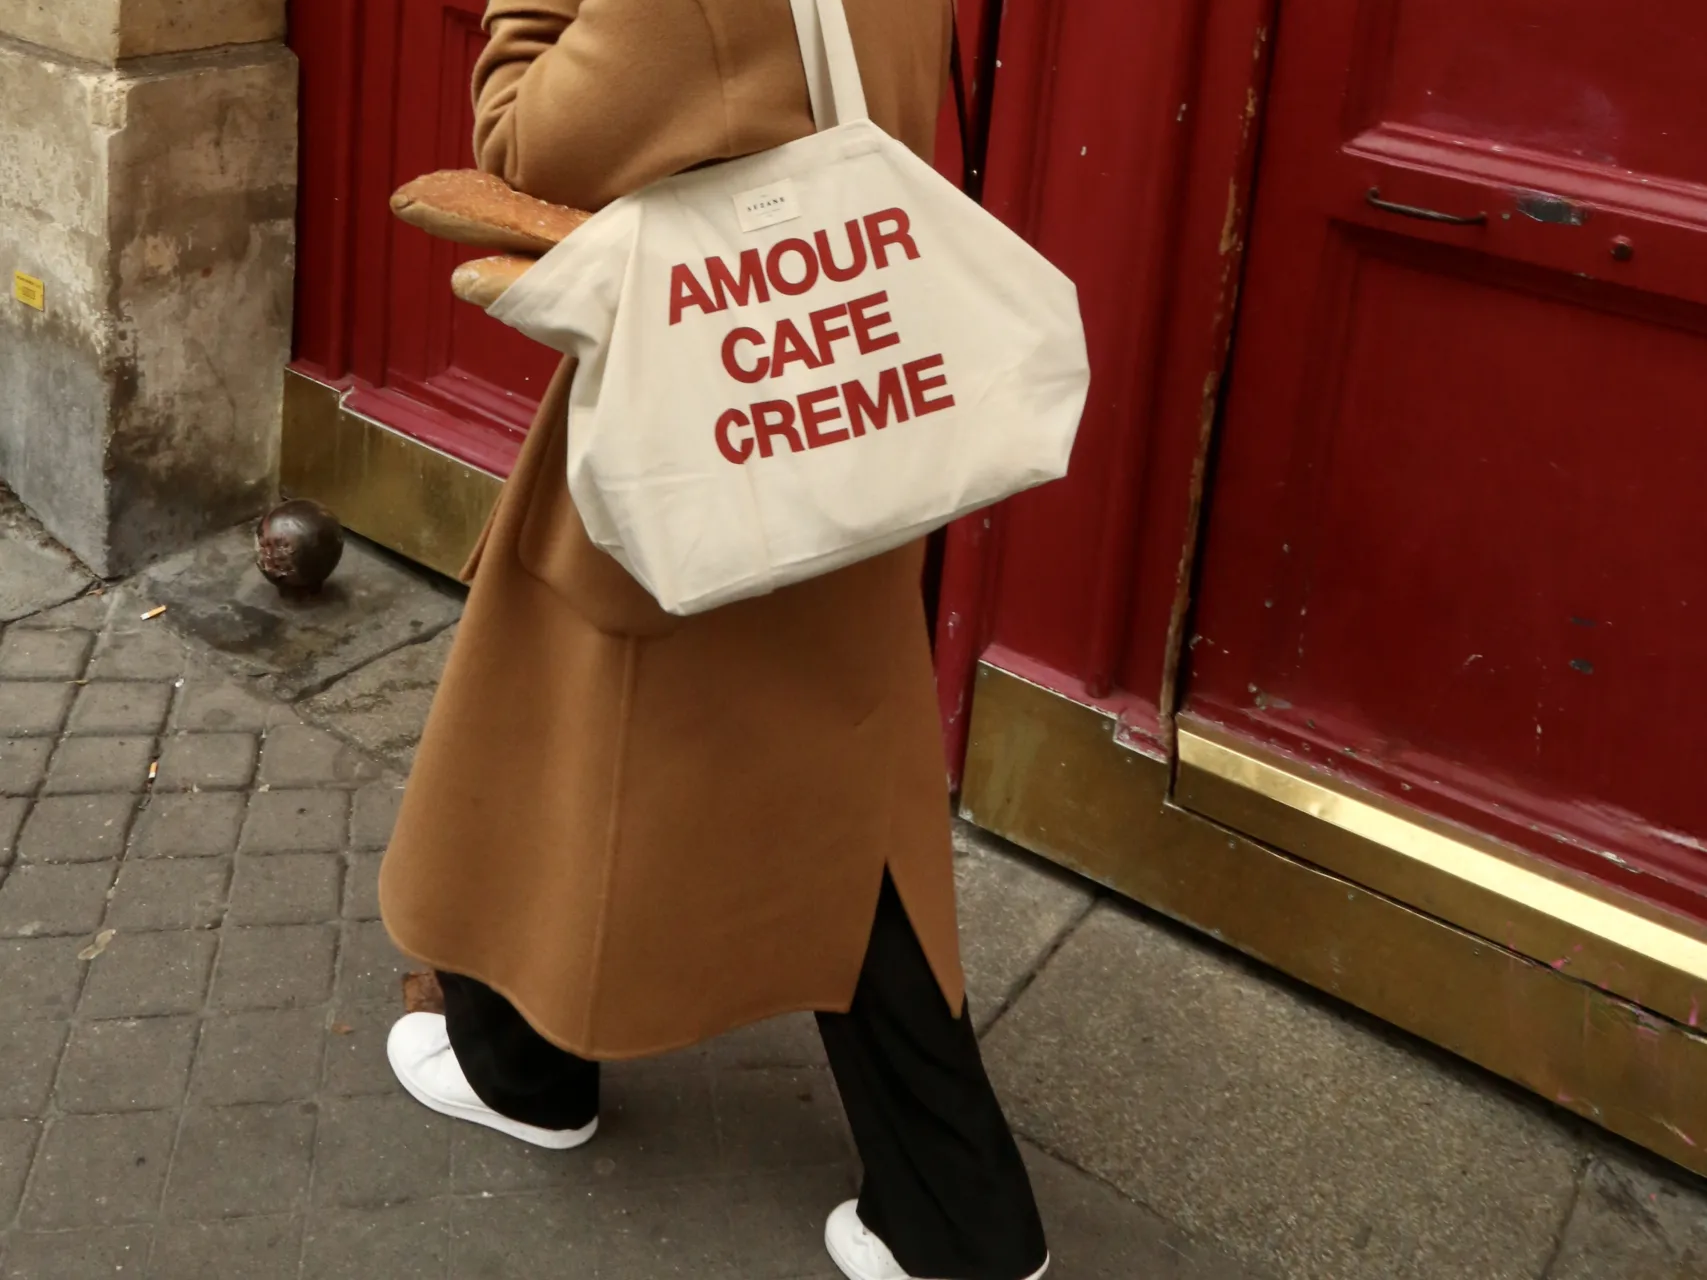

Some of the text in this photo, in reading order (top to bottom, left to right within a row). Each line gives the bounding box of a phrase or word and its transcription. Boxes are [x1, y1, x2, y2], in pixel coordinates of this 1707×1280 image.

[669, 207, 920, 326] AMOUR
[721, 290, 900, 384] CAFE
[715, 353, 956, 465] CREME
